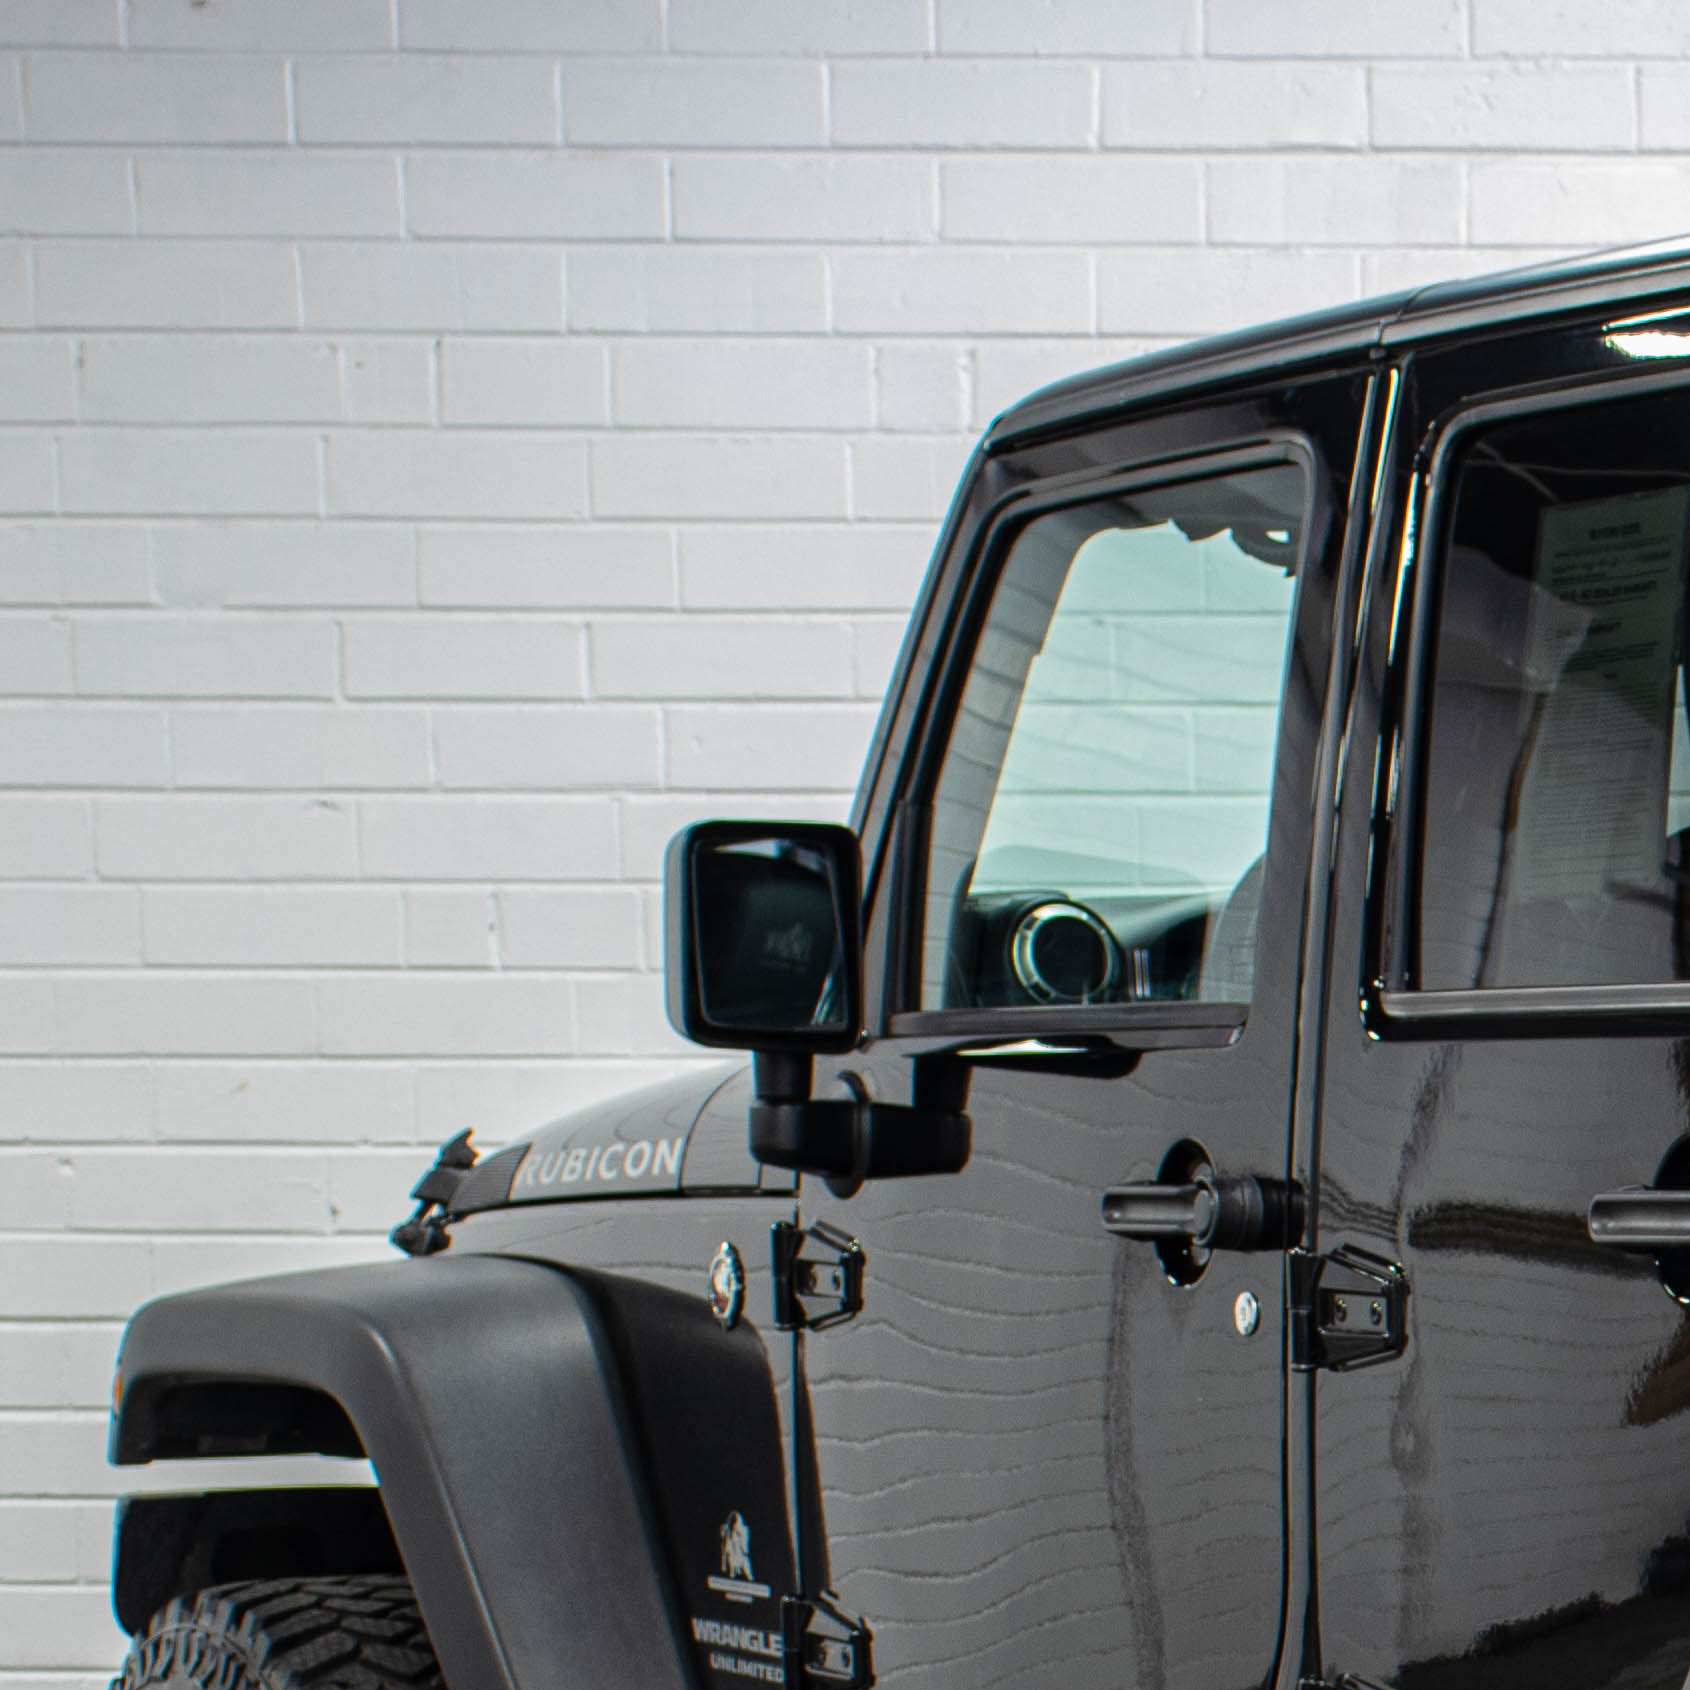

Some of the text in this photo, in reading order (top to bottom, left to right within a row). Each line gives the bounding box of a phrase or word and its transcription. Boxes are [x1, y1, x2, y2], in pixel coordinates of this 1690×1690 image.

[518, 1136, 683, 1186] RUBICON
[692, 1617, 784, 1658] WRANGLE
[708, 1652, 785, 1684] UNLIMITED
